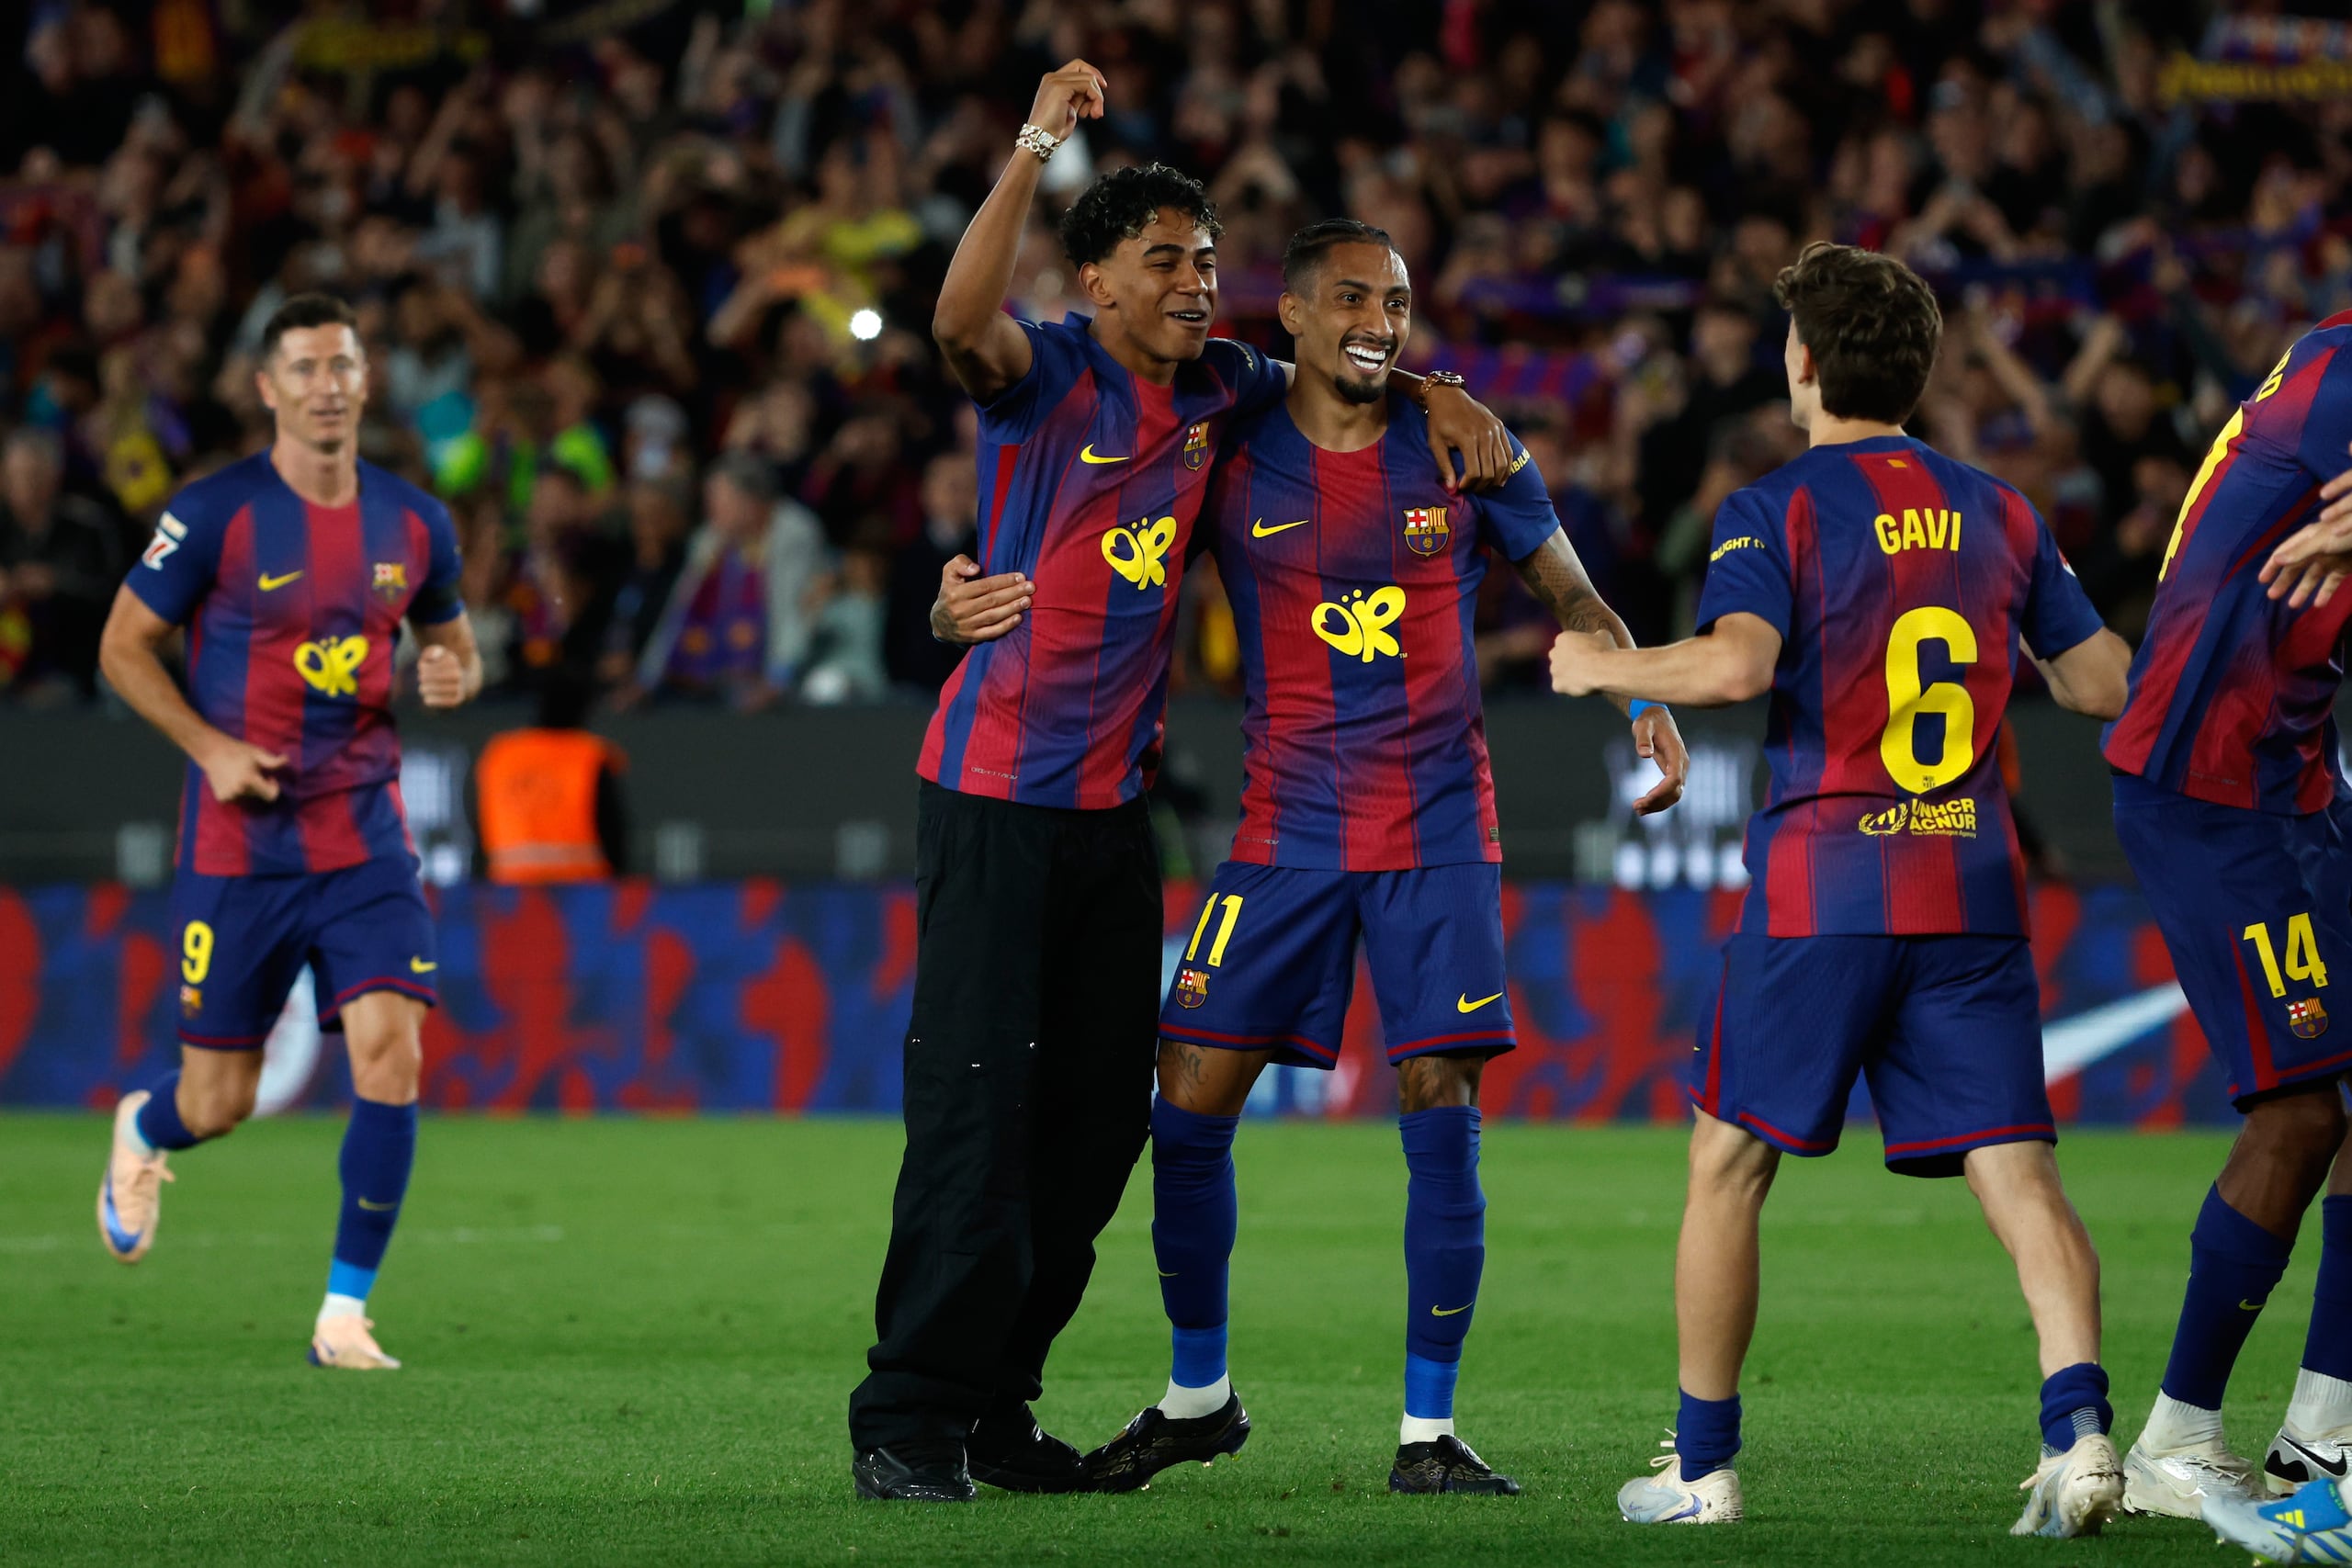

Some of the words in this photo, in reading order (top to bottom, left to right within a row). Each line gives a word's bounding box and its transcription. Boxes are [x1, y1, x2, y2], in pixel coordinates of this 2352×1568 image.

[1874, 508, 1962, 555] GAVI
[1880, 606, 1978, 795] 6
[1910, 814, 1976, 830] ACNUR
[1912, 798, 1975, 818] UNHCR
[181, 919, 215, 985] 9
[1185, 892, 1244, 968] 11
[2243, 912, 2329, 998] 14
